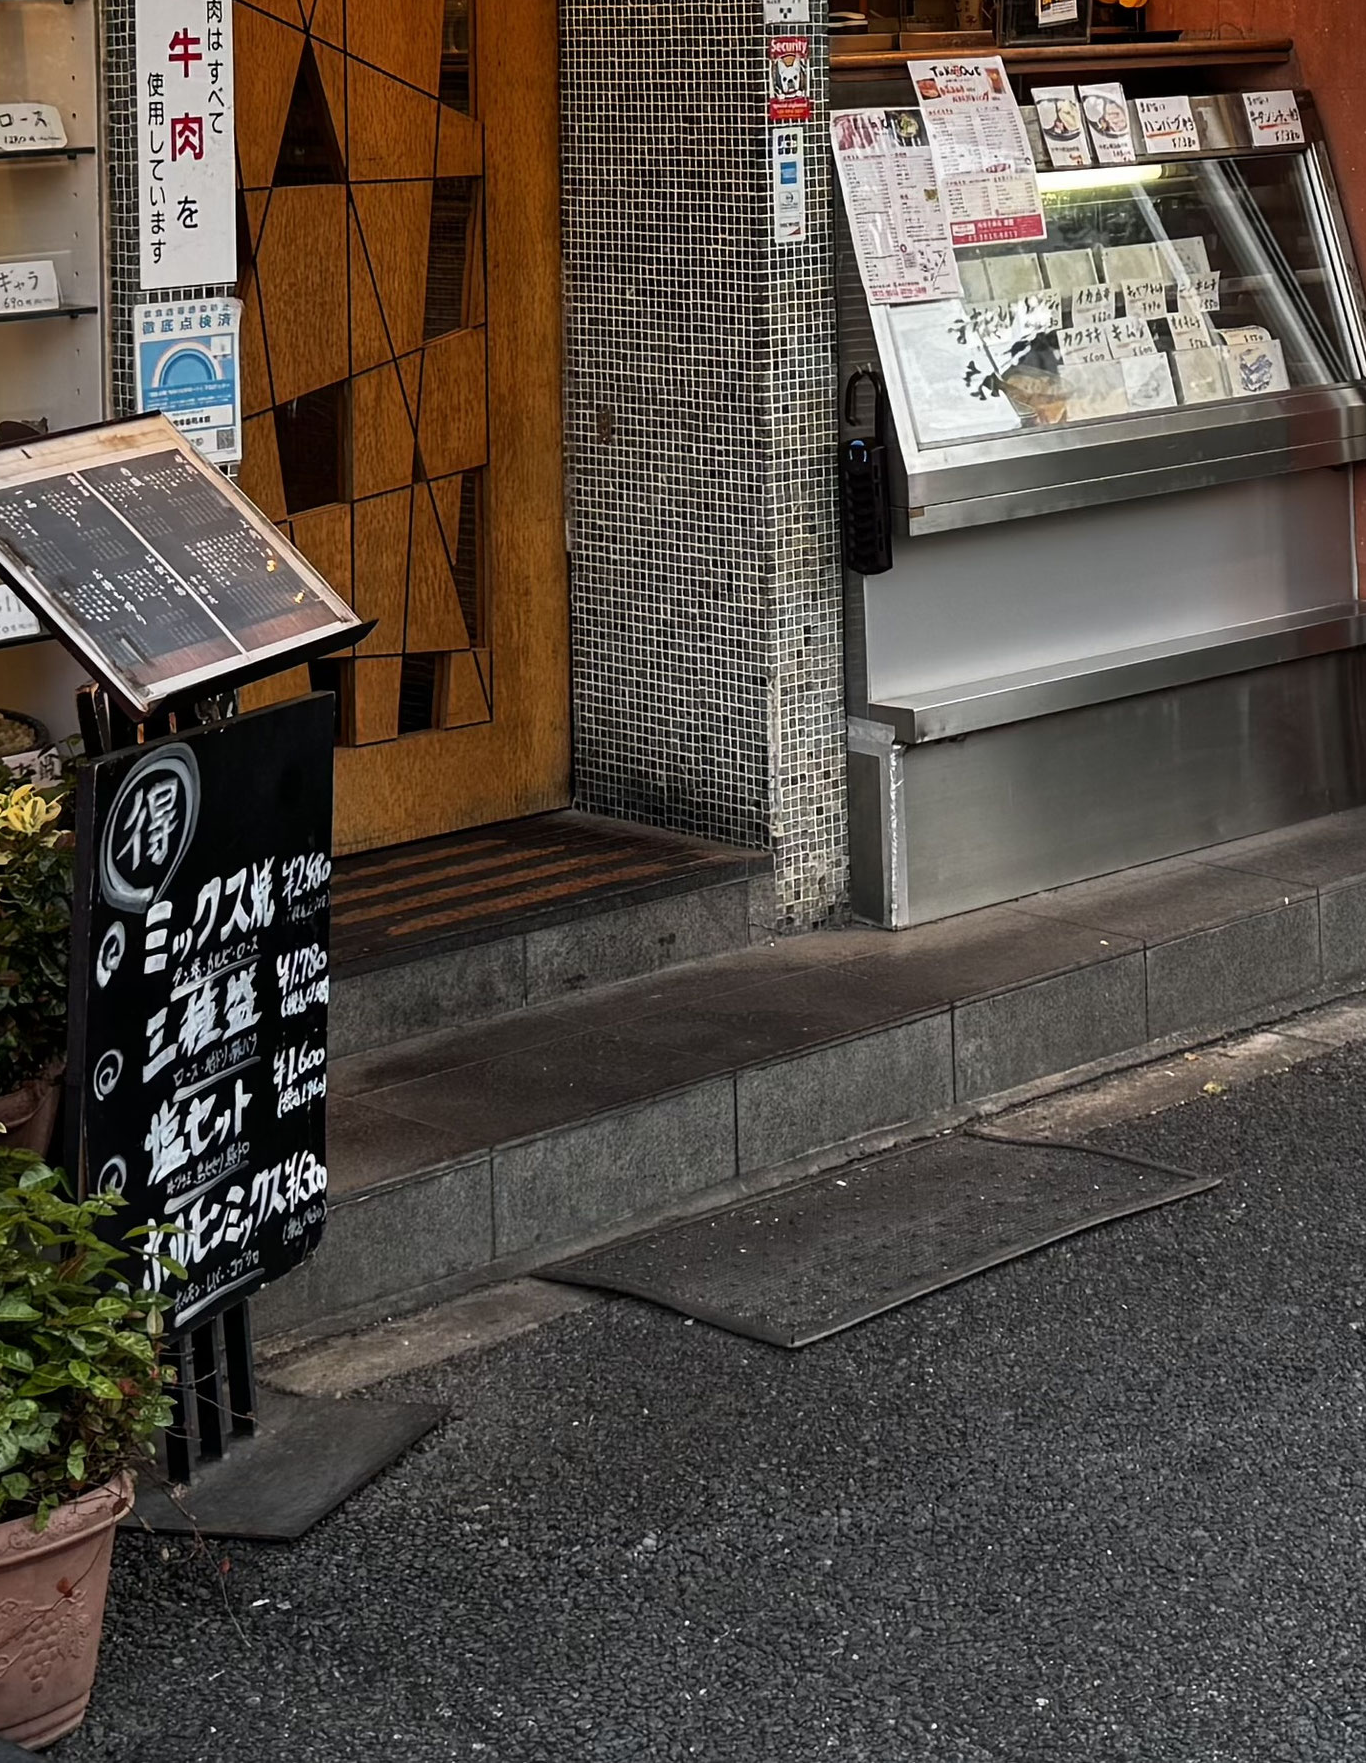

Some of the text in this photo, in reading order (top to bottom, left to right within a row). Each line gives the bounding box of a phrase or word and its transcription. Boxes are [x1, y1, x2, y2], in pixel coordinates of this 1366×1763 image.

[770, 39, 808, 53] Security
[146, 71, 167, 265] 使用しています
